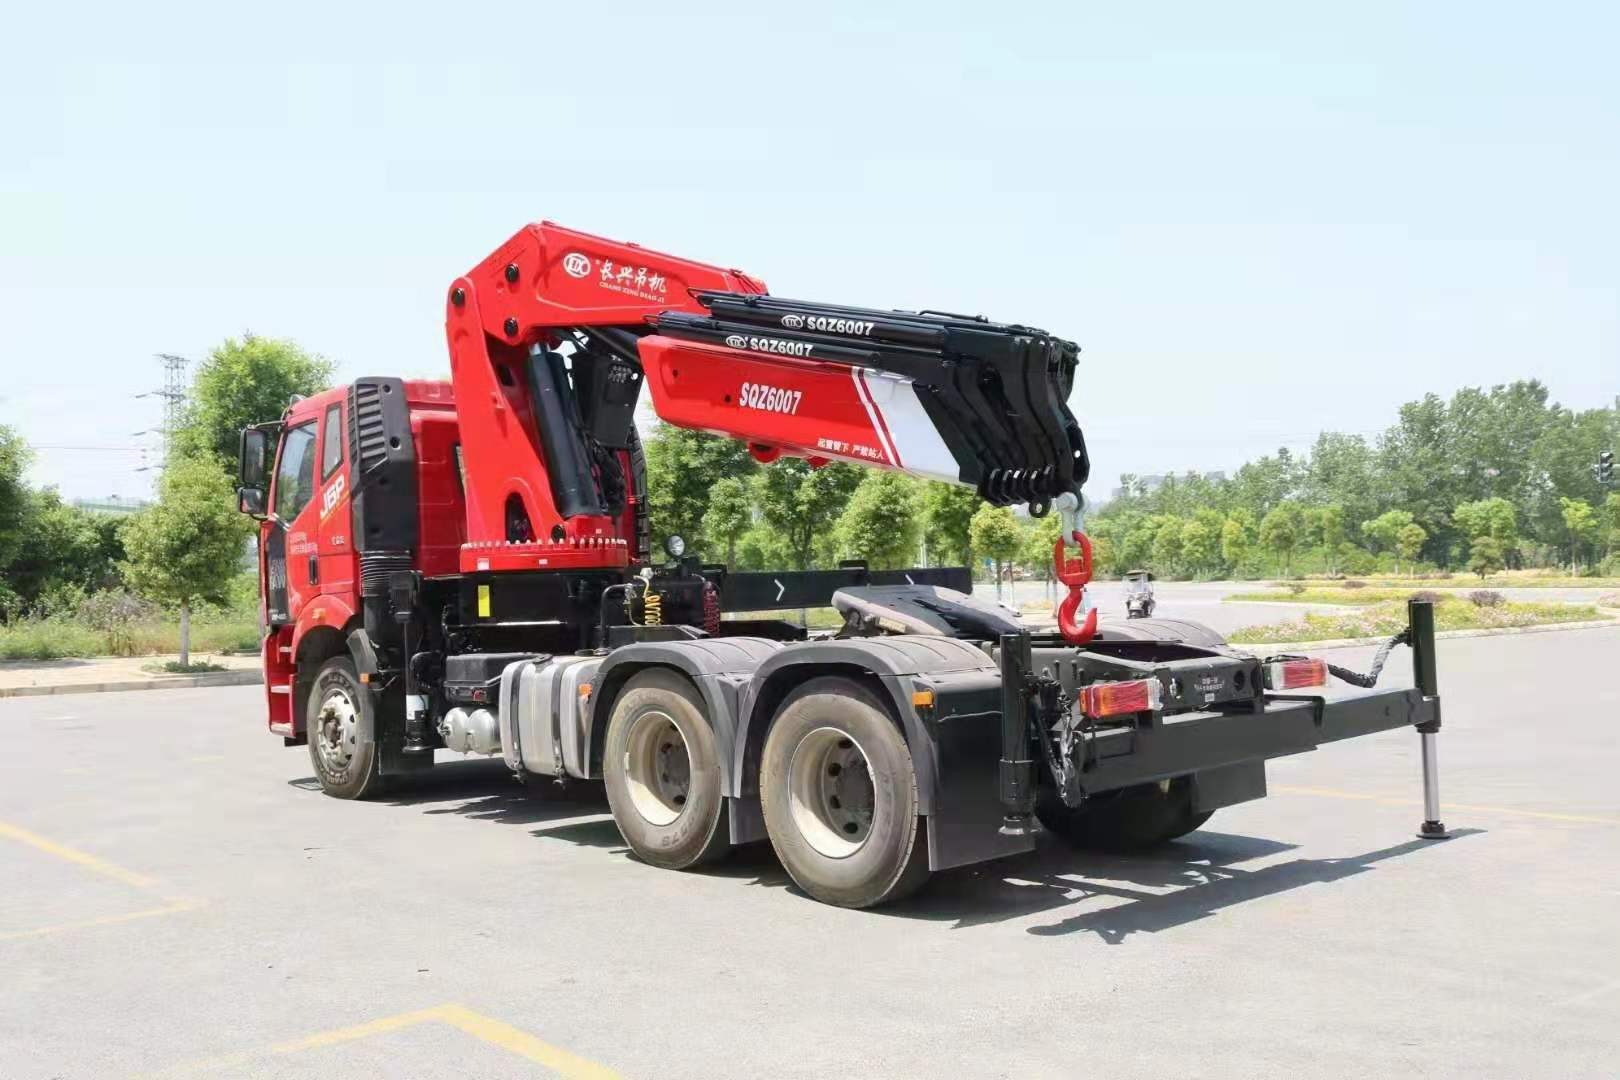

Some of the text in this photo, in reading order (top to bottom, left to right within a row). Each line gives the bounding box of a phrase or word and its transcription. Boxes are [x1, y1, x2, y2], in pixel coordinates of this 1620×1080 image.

[600, 259, 667, 293] 长兴吊机
[807, 316, 874, 336] SQZ6007
[750, 337, 814, 357] SQZ6007
[739, 382, 802, 415] SQZ6007
